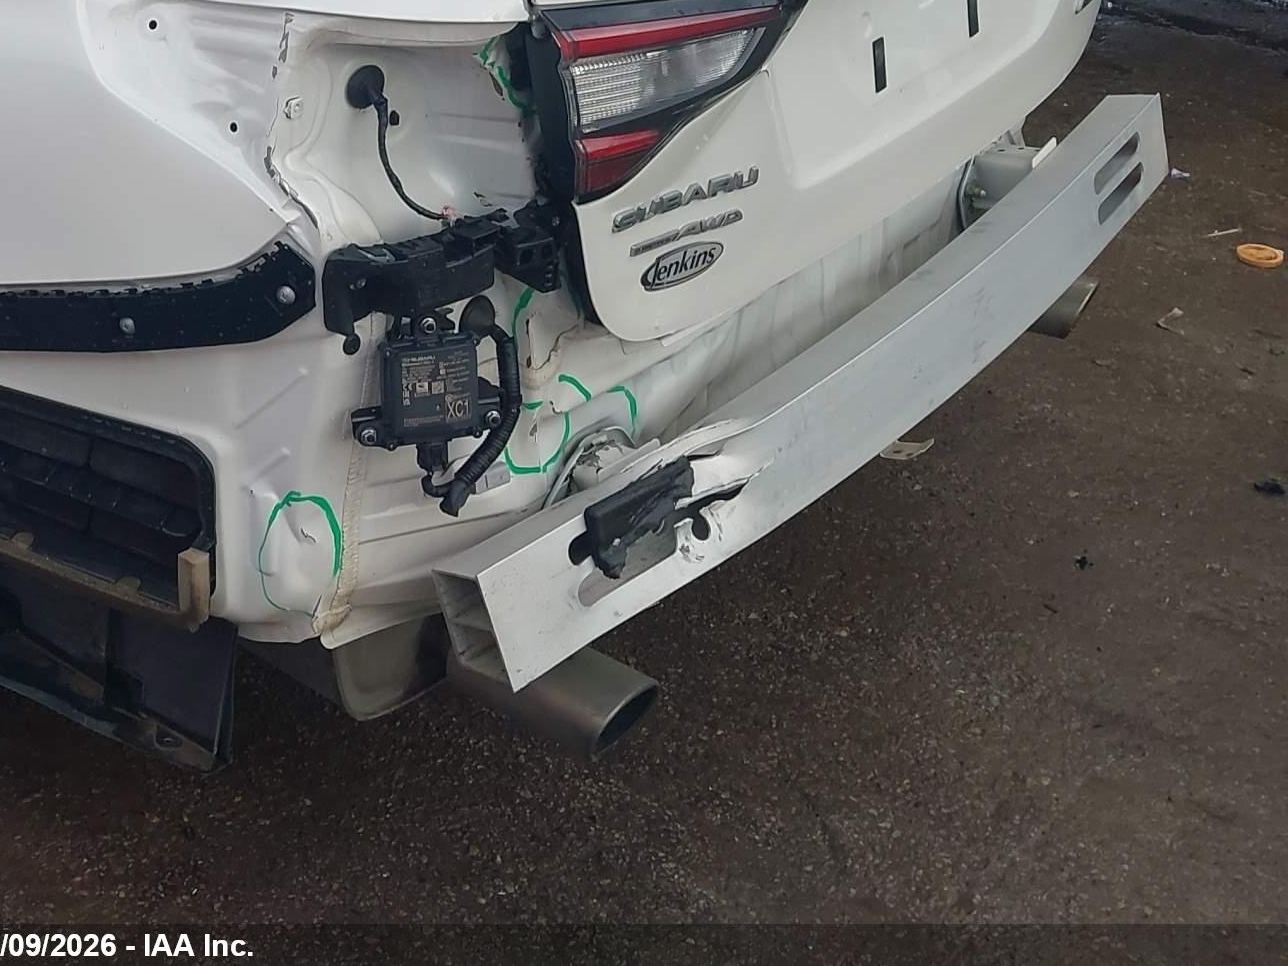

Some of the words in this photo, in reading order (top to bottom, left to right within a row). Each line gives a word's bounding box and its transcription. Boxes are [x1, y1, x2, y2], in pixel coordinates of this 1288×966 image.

[611, 165, 760, 234] SUBARU
[675, 209, 744, 240] AWD
[641, 244, 718, 291] Jenkins
[447, 398, 470, 420] XC1
